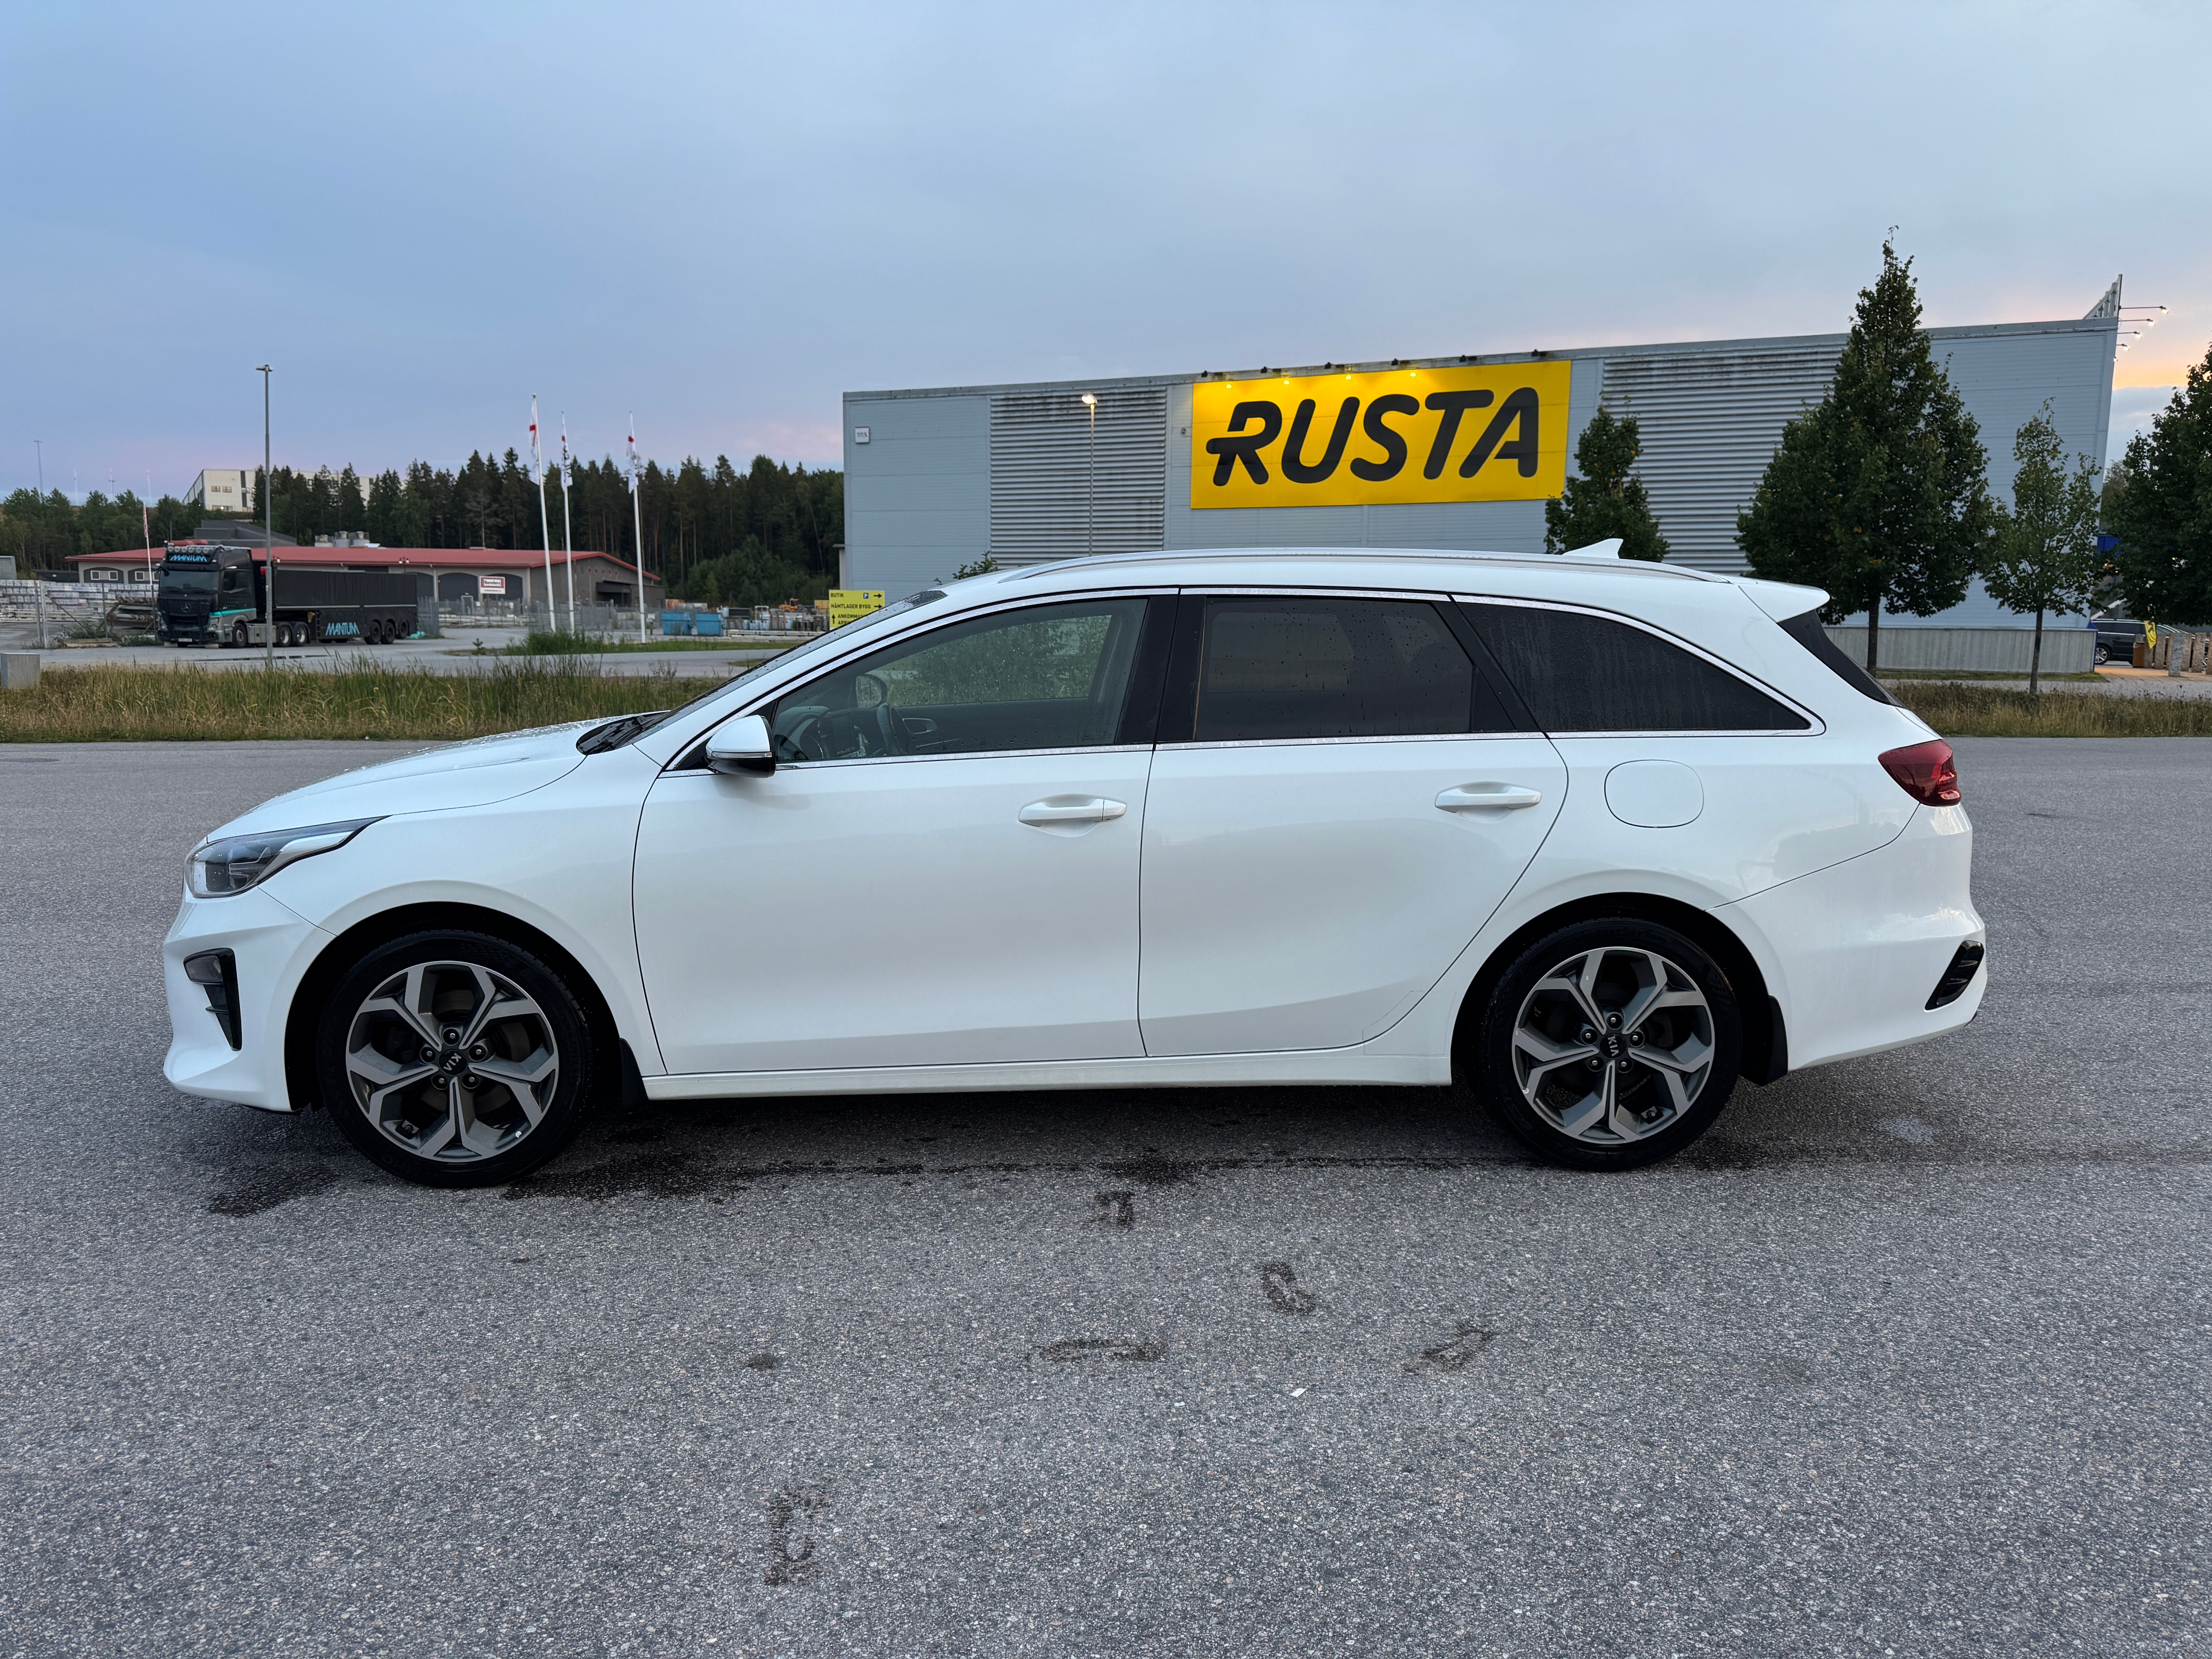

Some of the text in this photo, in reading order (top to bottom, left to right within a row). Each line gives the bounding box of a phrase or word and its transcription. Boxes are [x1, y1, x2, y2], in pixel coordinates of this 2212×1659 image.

[1206, 387, 1539, 486] RUSTA
[1607, 1035, 1619, 1057] KIA
[443, 1053, 462, 1071] KIA
